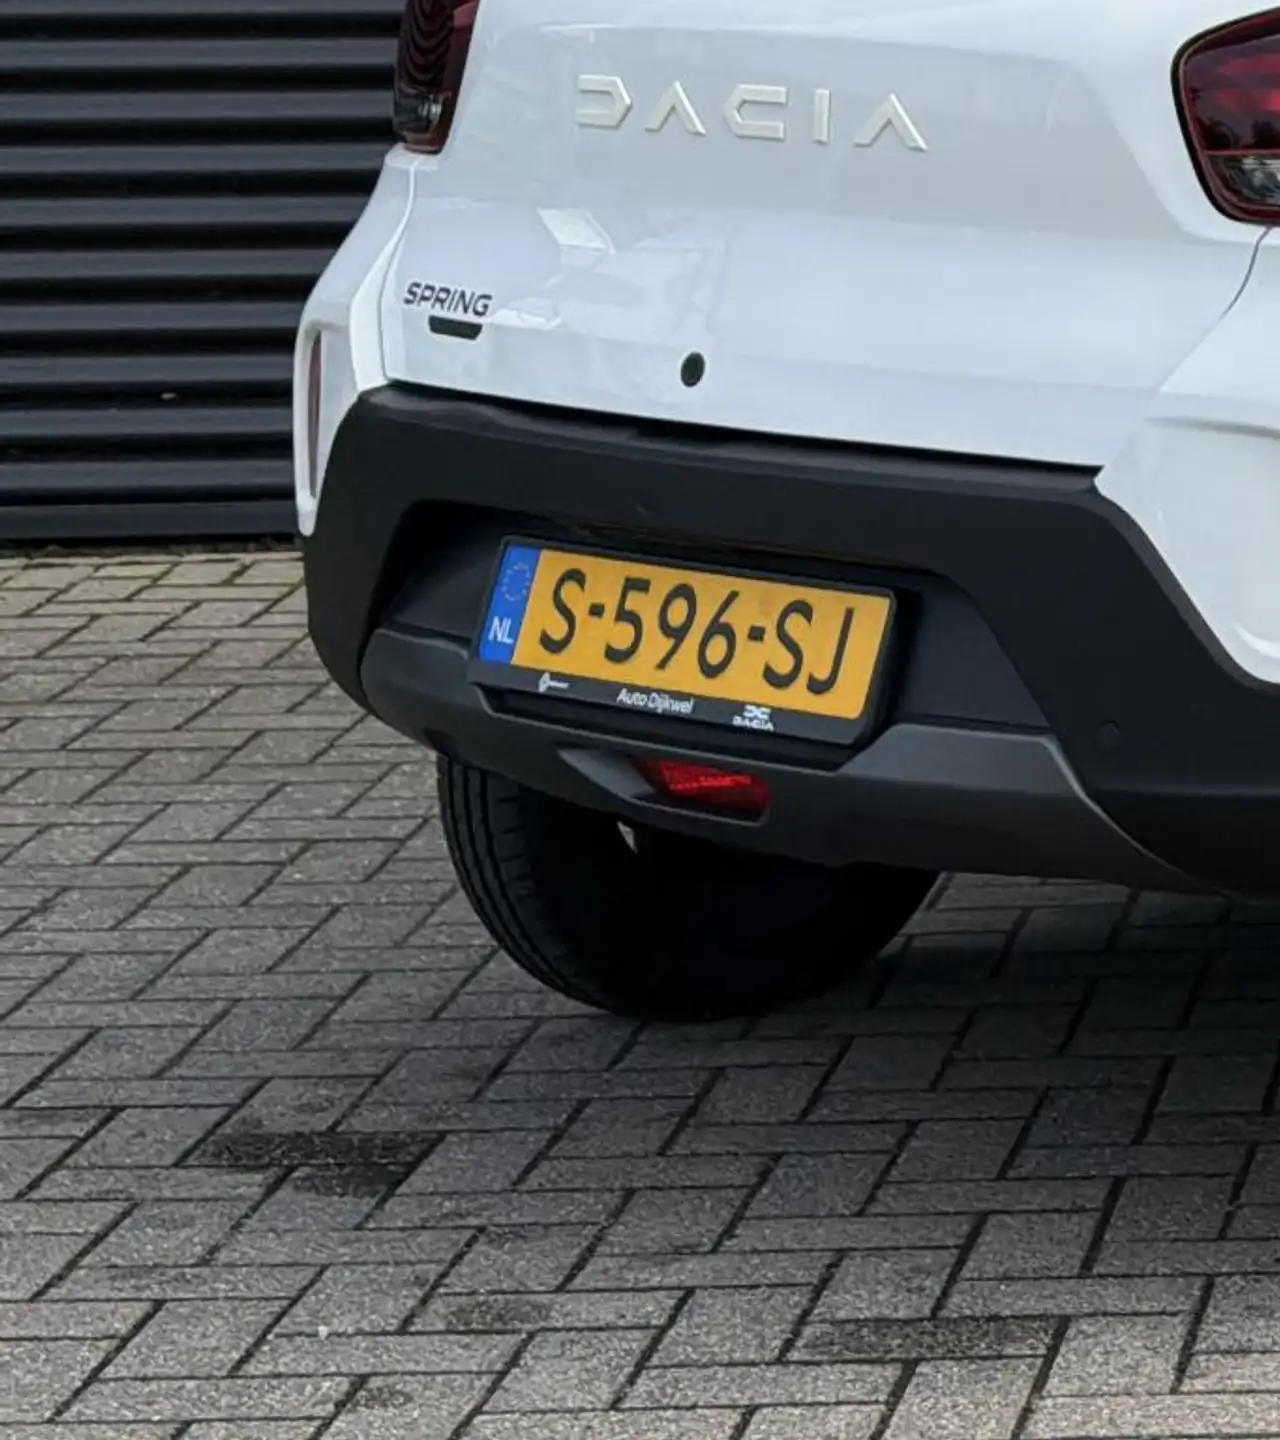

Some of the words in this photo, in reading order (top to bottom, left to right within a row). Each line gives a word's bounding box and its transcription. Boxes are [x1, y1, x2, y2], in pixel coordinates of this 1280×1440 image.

[575, 73, 928, 152] DACIA
[403, 282, 493, 317] SPRING
[488, 617, 514, 645] NL
[538, 568, 856, 696] S-596-SJ
[616, 687, 648, 707] Auto
